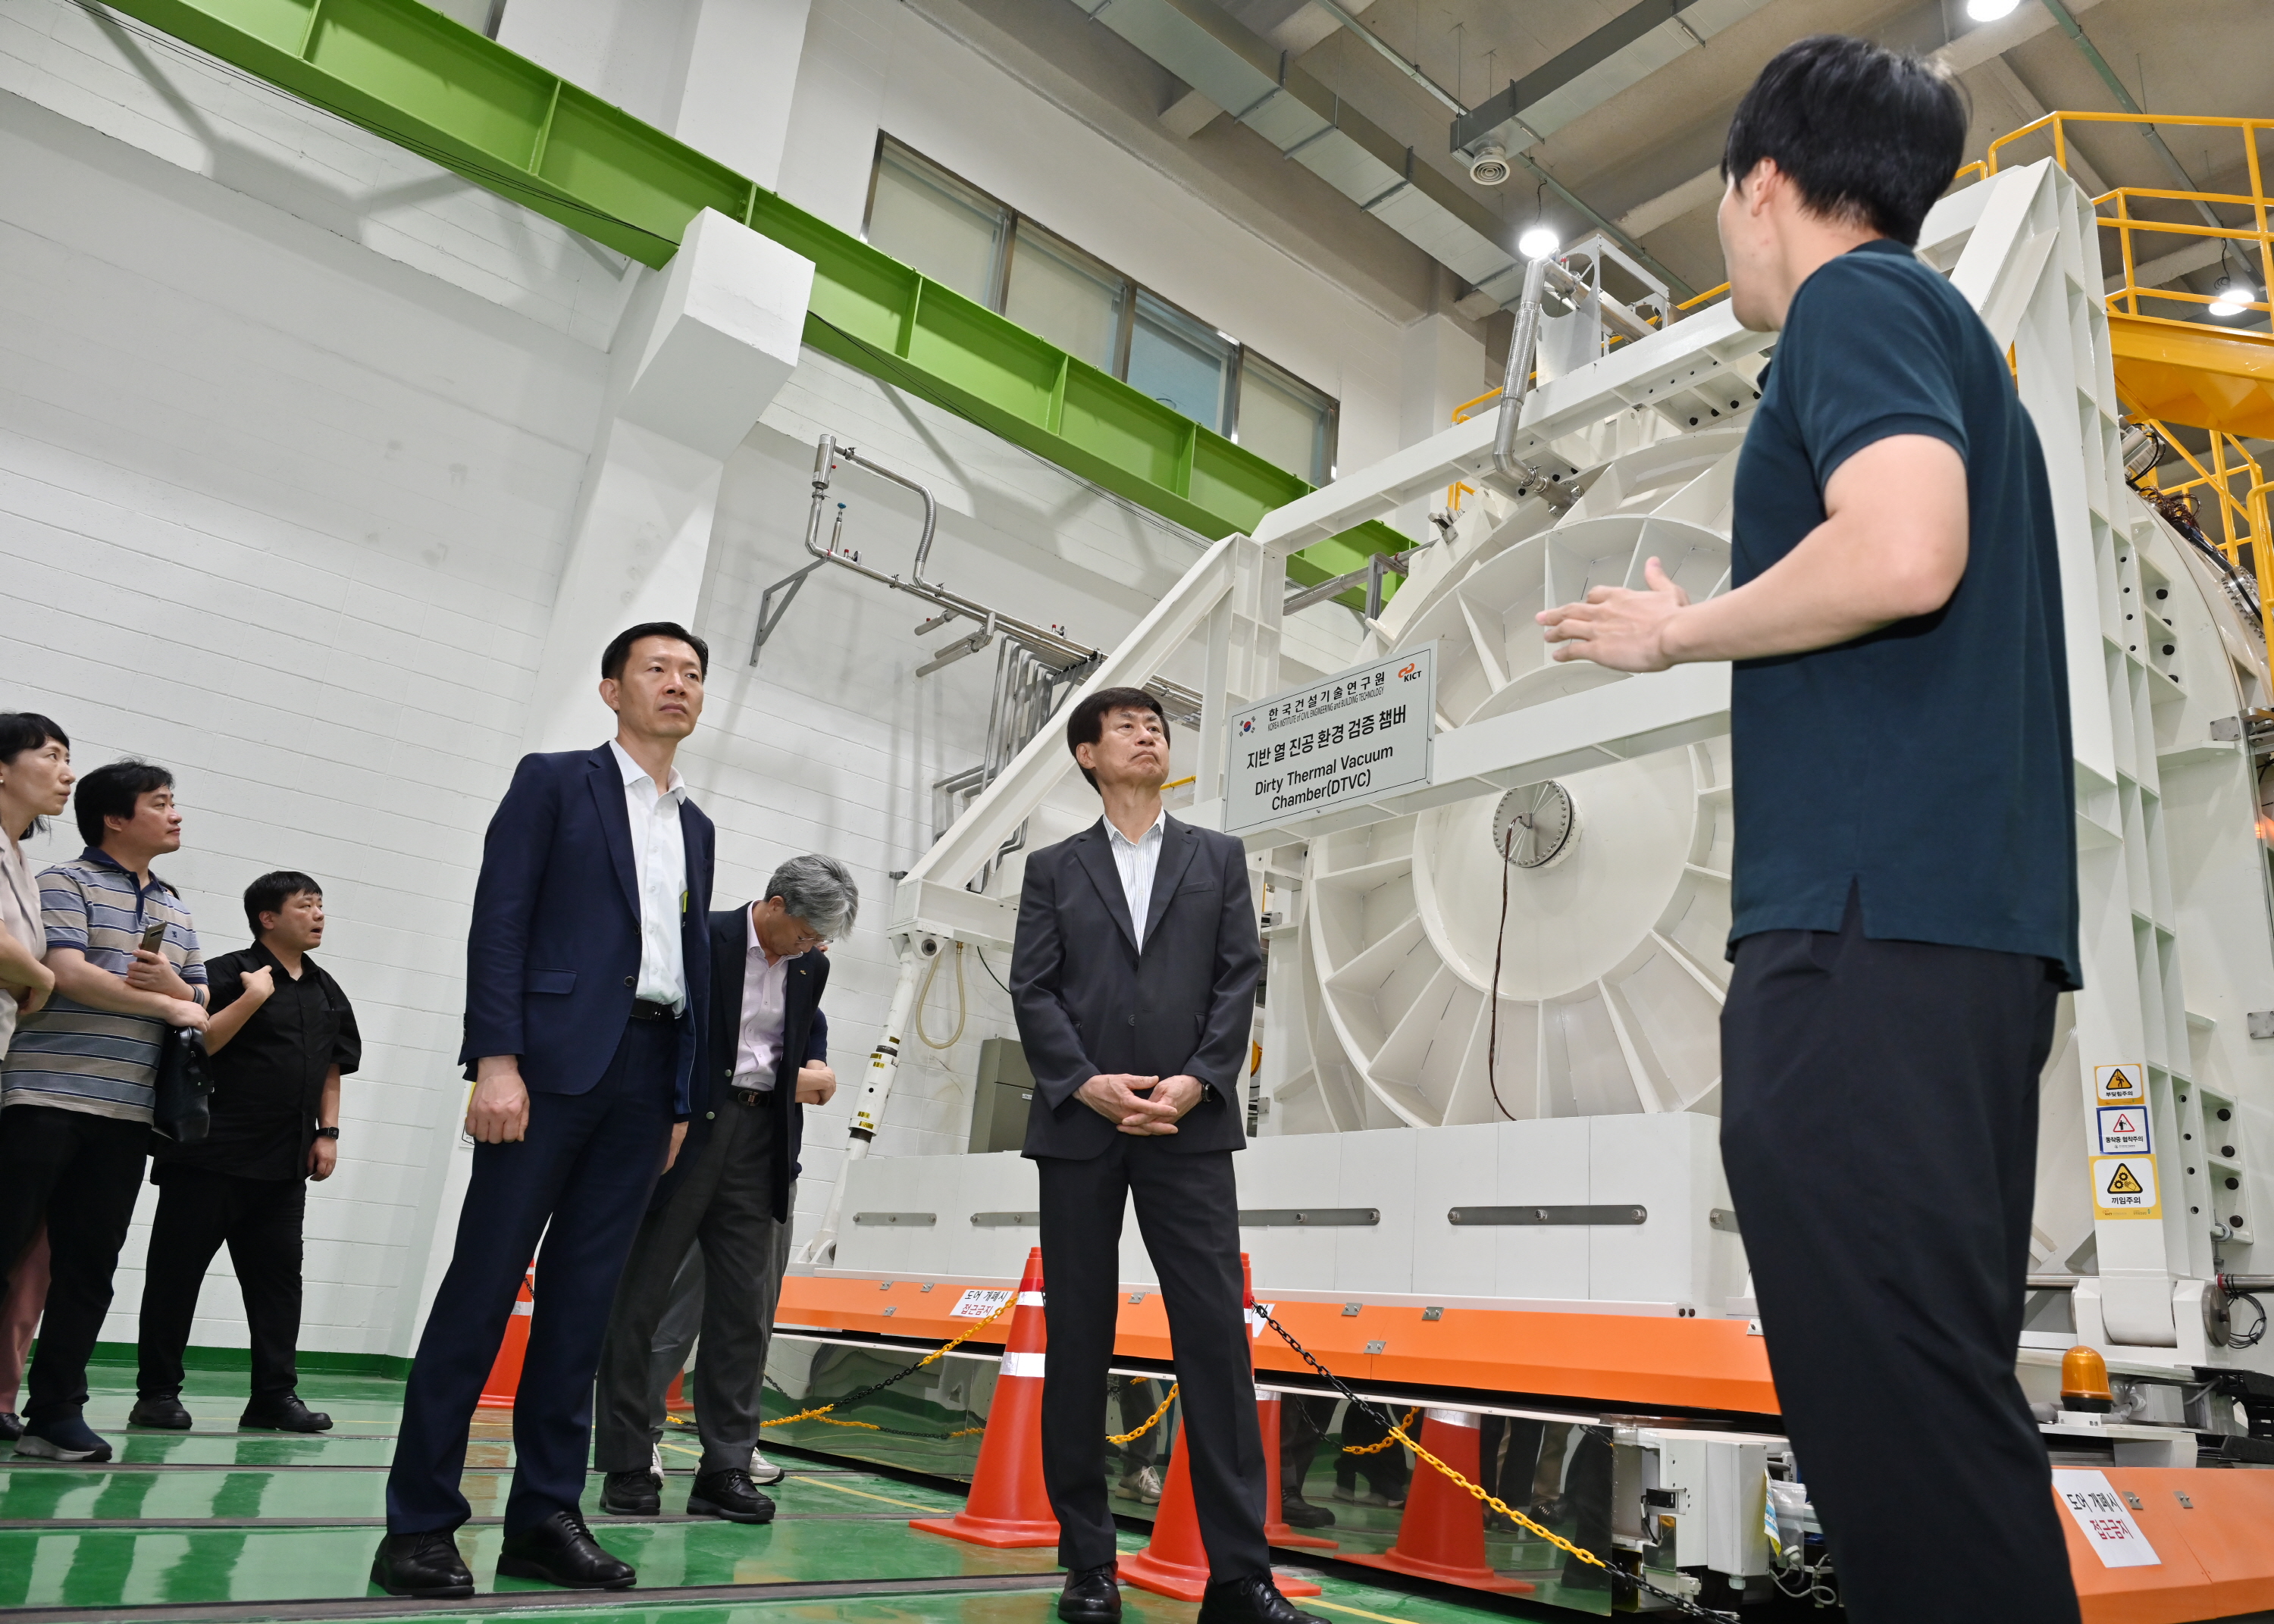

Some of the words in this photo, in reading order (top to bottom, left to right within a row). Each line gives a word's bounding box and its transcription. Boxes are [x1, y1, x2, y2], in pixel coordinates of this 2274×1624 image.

[1404, 671, 1422, 682] KICT
[1269, 671, 1385, 721] 한국건설기술연구원
[1268, 721, 1280, 731] KOREA
[1280, 715, 1296, 728] INSTITUTE
[1301, 711, 1310, 721] CIVIL
[1310, 702, 1333, 717] ENGINEERING
[1341, 695, 1358, 709] BUILDING
[1359, 686, 1385, 702] TECHNOLOGY
[1247, 747, 1271, 769] 지반
[1274, 743, 1285, 763] 열
[1289, 734, 1314, 758] 진공
[1317, 724, 1344, 749] 환경
[1348, 715, 1374, 740] 검증
[1379, 704, 1406, 731] 챔버
[1255, 776, 1283, 796] Dirty
[1287, 759, 1336, 786] Thermal
[1341, 746, 1393, 770] Vacuum
[1271, 768, 1371, 811] Chamber(DTVC)
[2111, 1196, 2141, 1205] 끼임주의
[965, 1291, 983, 1300] 도어
[983, 1291, 1009, 1302] 개폐시
[961, 1303, 994, 1316] 접근금지
[2066, 1492, 2093, 1513] 도어
[2088, 1492, 2122, 1513] 개폐시
[2090, 1519, 2134, 1540] 접근금지
